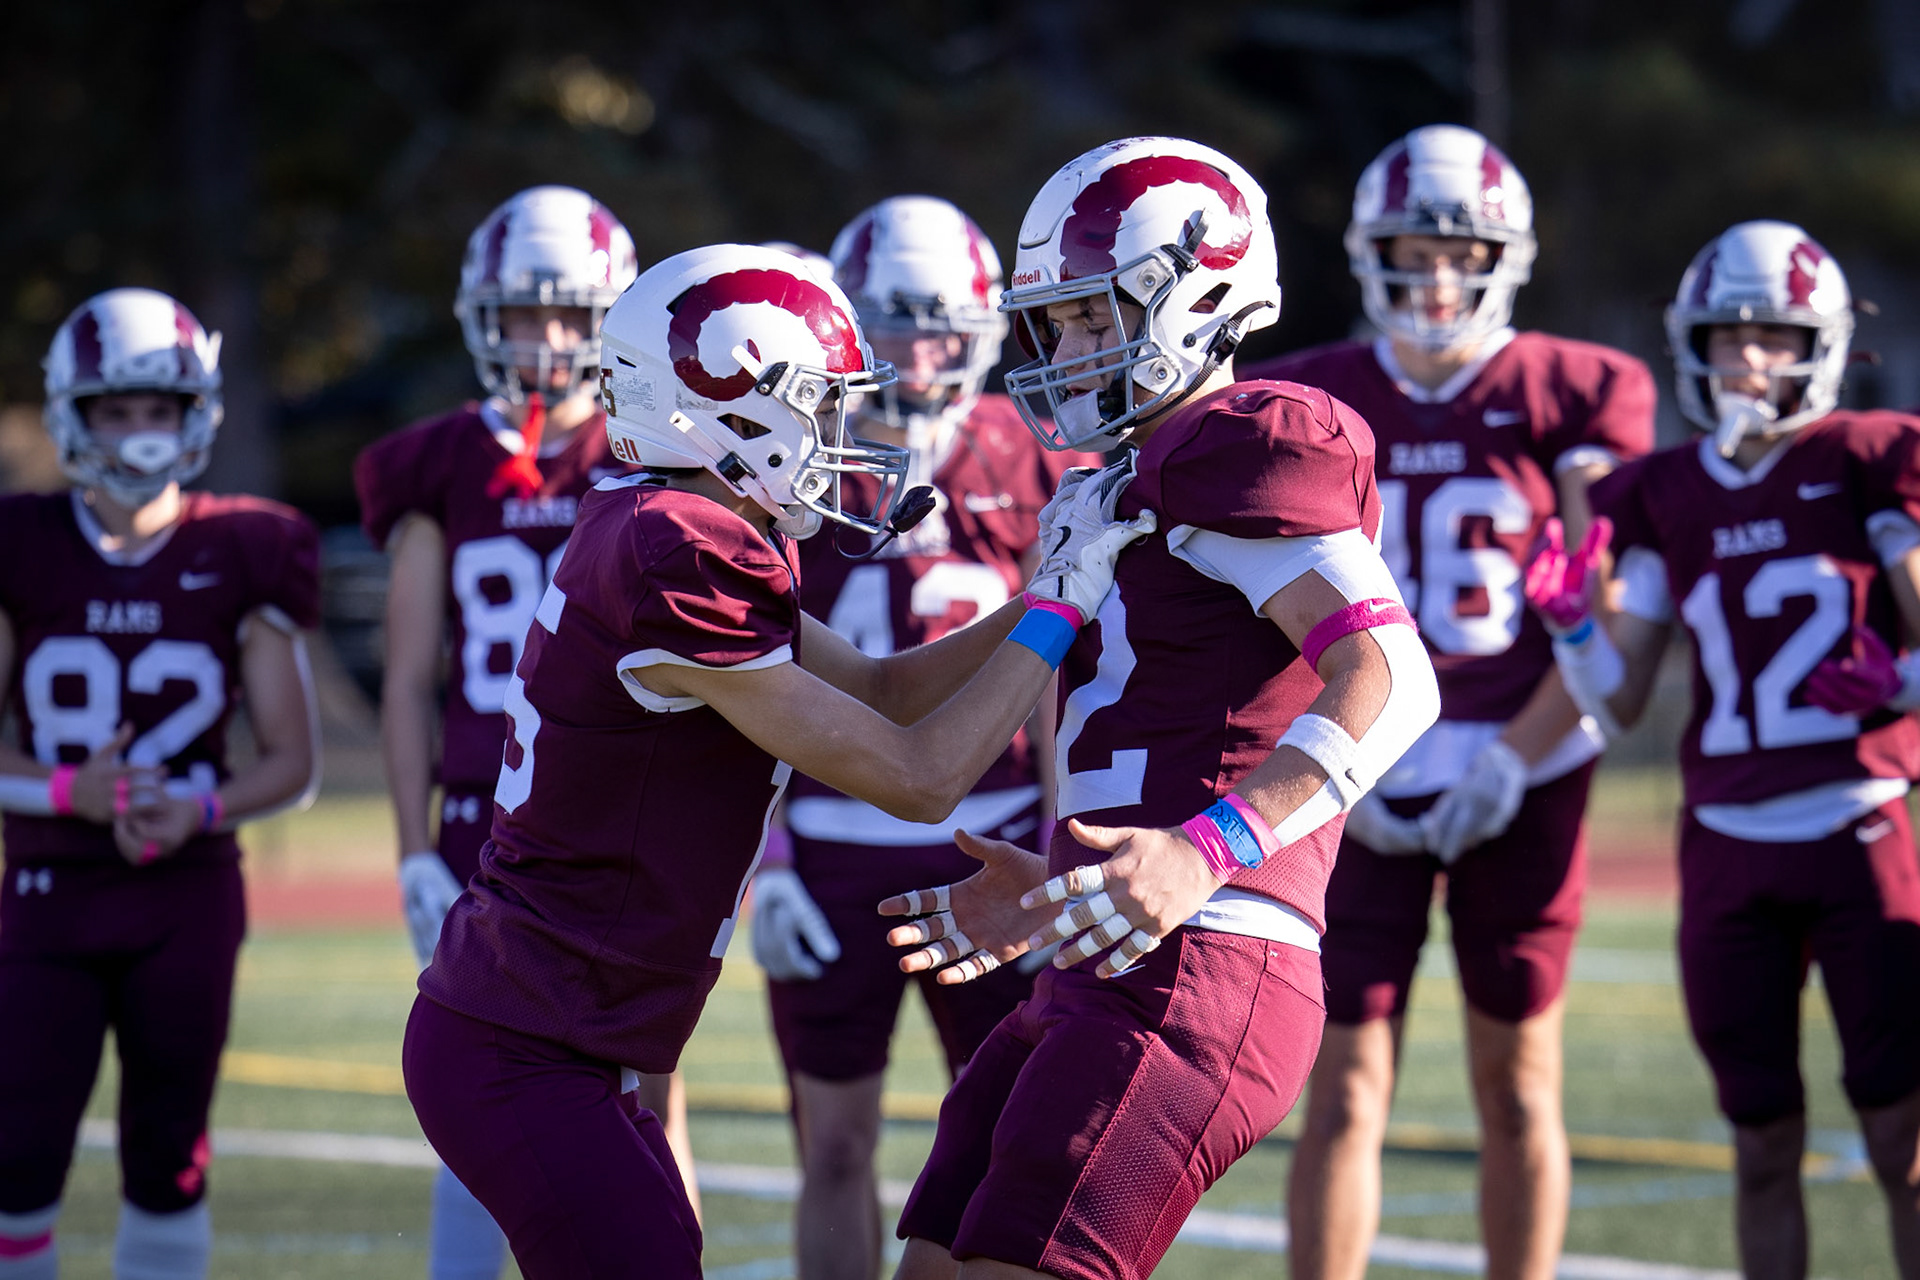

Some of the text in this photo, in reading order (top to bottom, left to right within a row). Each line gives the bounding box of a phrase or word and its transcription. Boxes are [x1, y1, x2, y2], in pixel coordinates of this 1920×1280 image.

[609, 434, 642, 463] ell
[1389, 441, 1467, 475] RAMS
[502, 496, 578, 529] RAMS
[1712, 517, 1787, 560] RAMS
[85, 600, 163, 634] RAMS
[452, 534, 570, 714] 8
[1681, 552, 1860, 757] 12
[23, 634, 225, 800] 82
